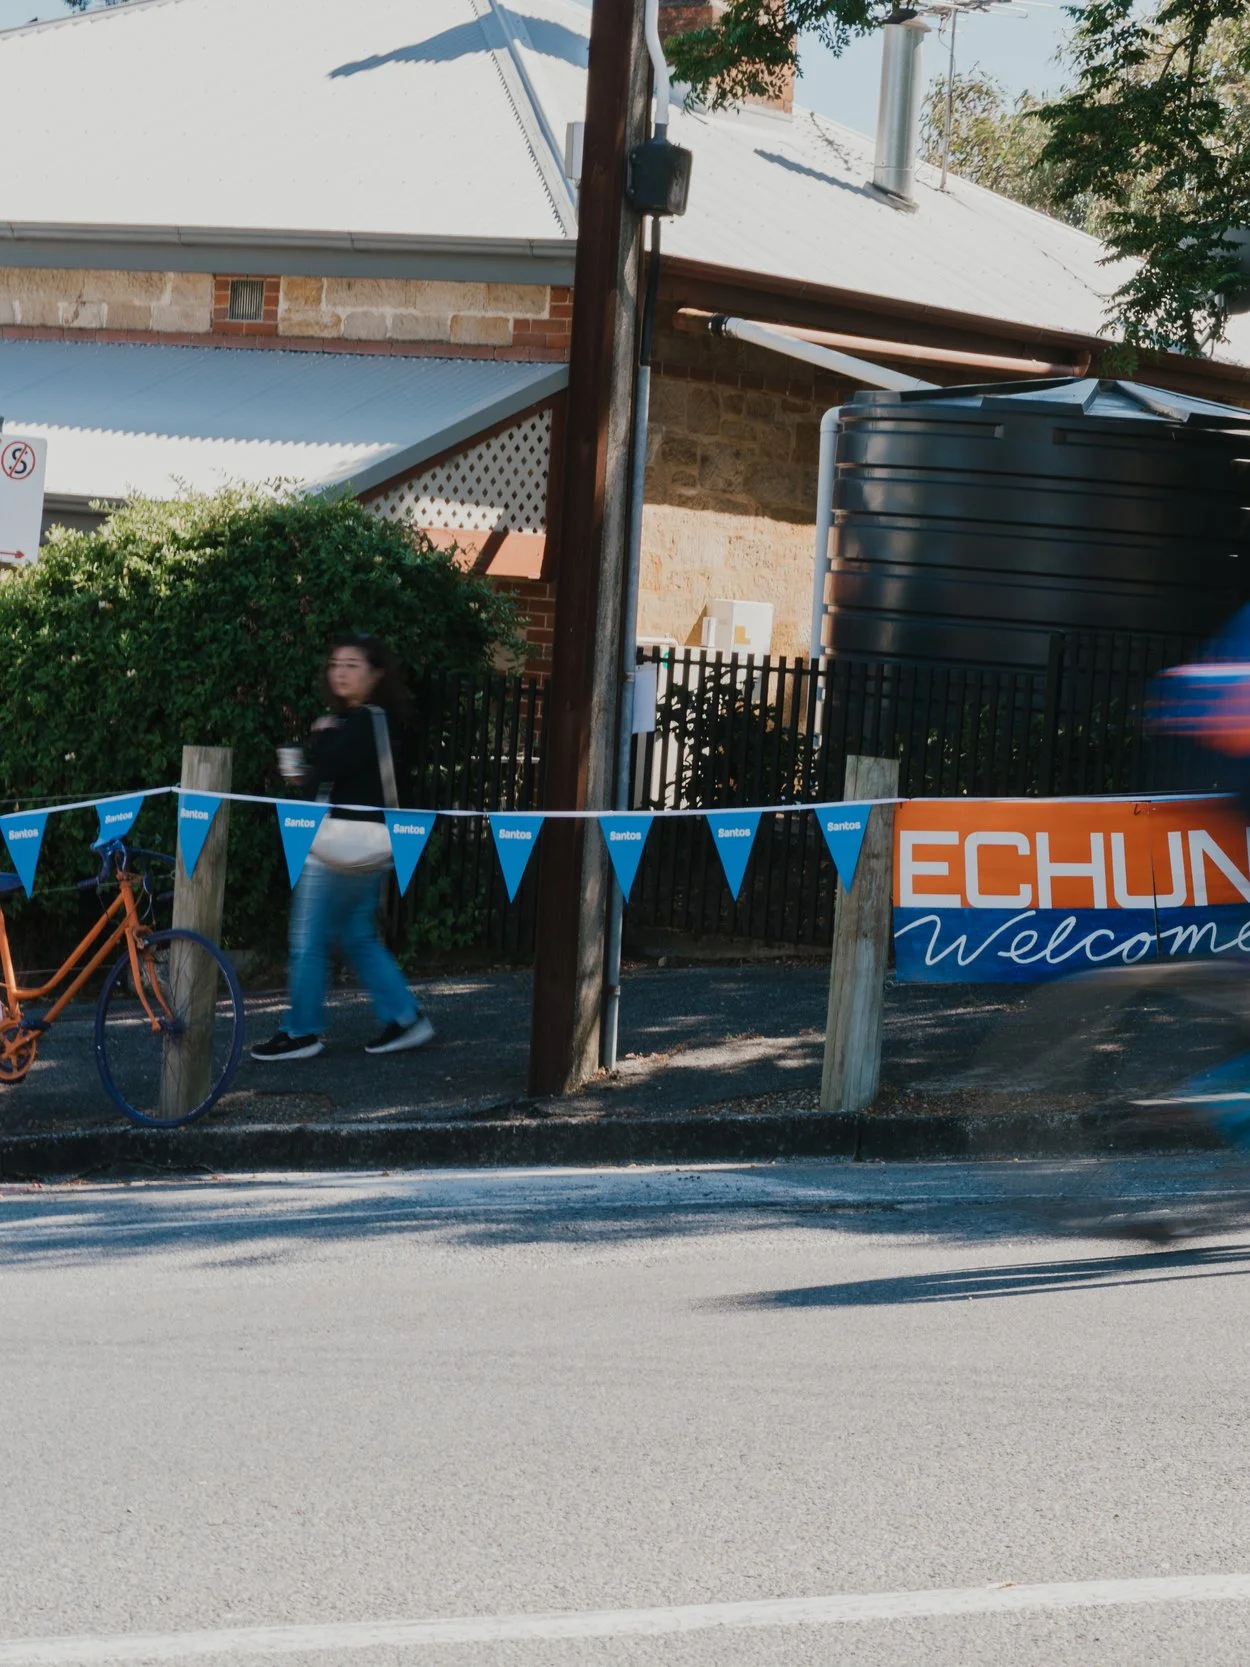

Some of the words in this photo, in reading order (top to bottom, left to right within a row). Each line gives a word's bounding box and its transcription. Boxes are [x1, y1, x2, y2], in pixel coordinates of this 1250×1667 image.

[105, 811, 133, 826] Santos
[180, 808, 209, 821] Santos
[284, 817, 316, 828] Santos
[828, 821, 862, 832] Santos
[9, 828, 39, 841] Santos
[392, 824, 425, 835] Santos
[499, 829, 532, 840] Santos
[718, 828, 751, 838] Santos
[610, 831, 642, 841] Santos
